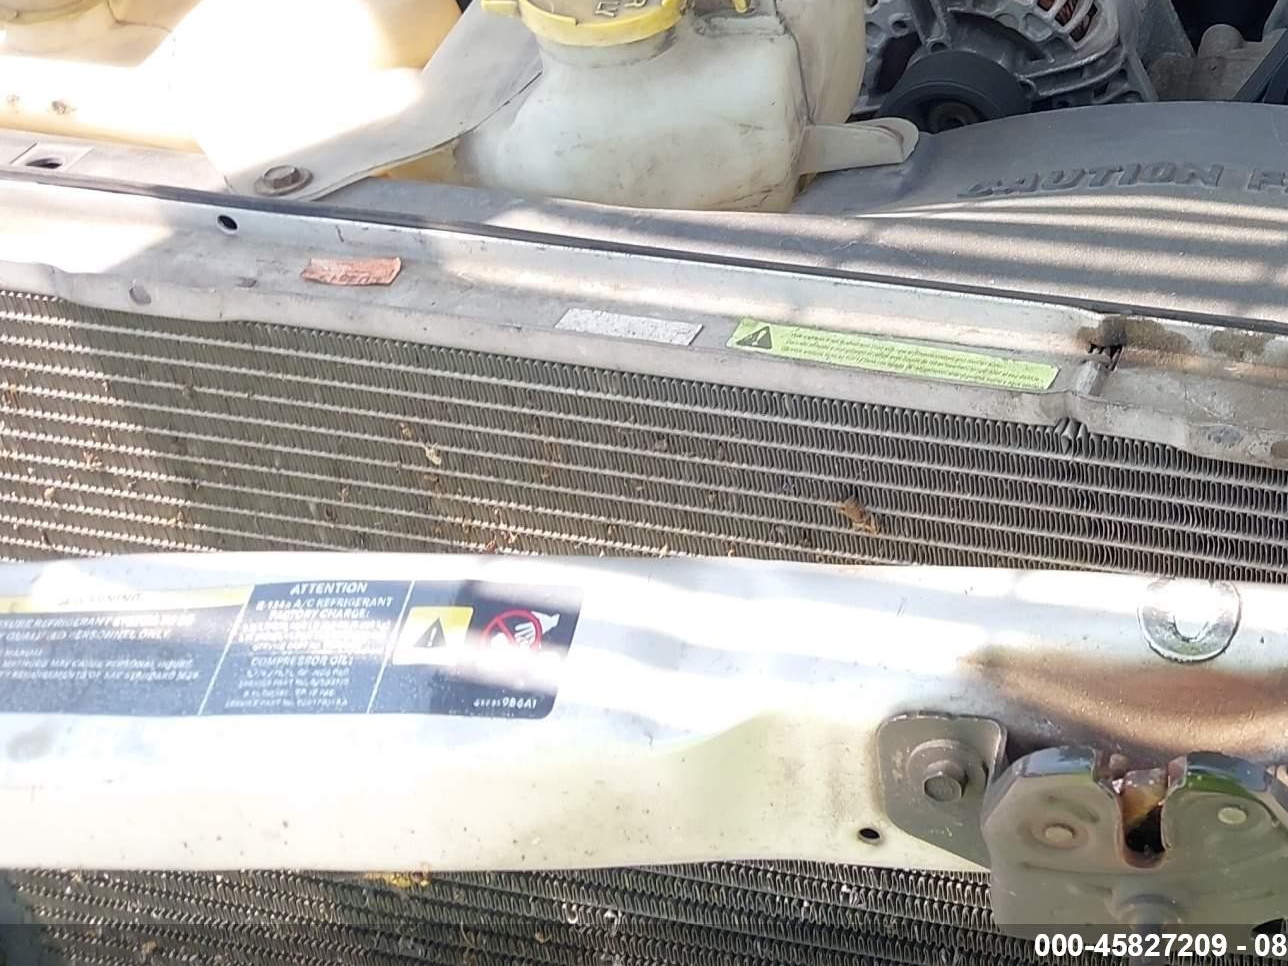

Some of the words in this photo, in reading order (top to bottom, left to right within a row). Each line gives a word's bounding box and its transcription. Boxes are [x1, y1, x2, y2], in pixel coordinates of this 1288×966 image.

[957, 163, 1224, 198] CAUTION
[290, 582, 369, 596] ATTENTION
[293, 598, 315, 609] A/C
[316, 596, 393, 609] REFRIGERANT
